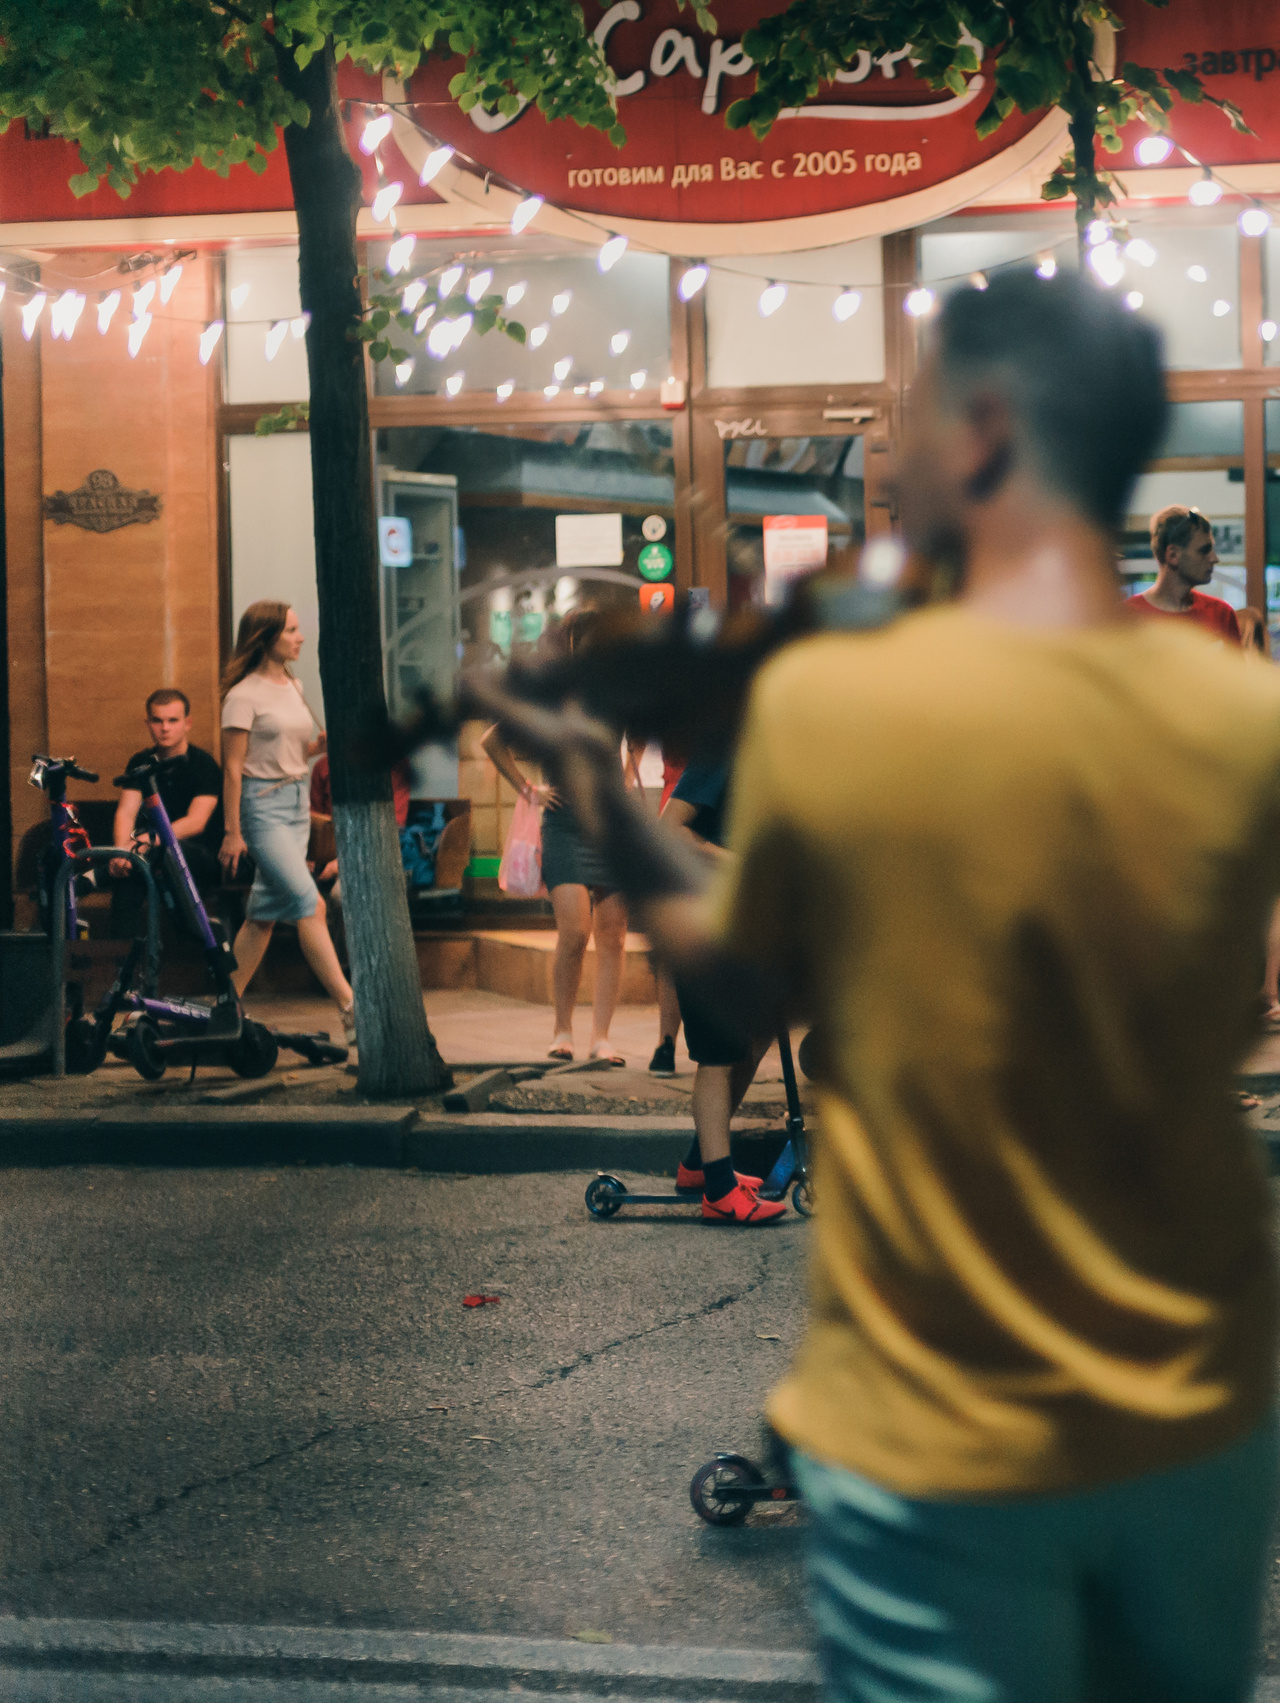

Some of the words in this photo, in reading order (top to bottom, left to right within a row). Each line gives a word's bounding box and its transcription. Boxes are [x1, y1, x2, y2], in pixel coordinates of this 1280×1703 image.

[568, 163, 664, 189] готовим
[671, 160, 714, 188] для
[720, 156, 766, 181] Вас
[771, 161, 786, 179] с
[792, 149, 858, 178] 2005
[865, 149, 922, 178] года
